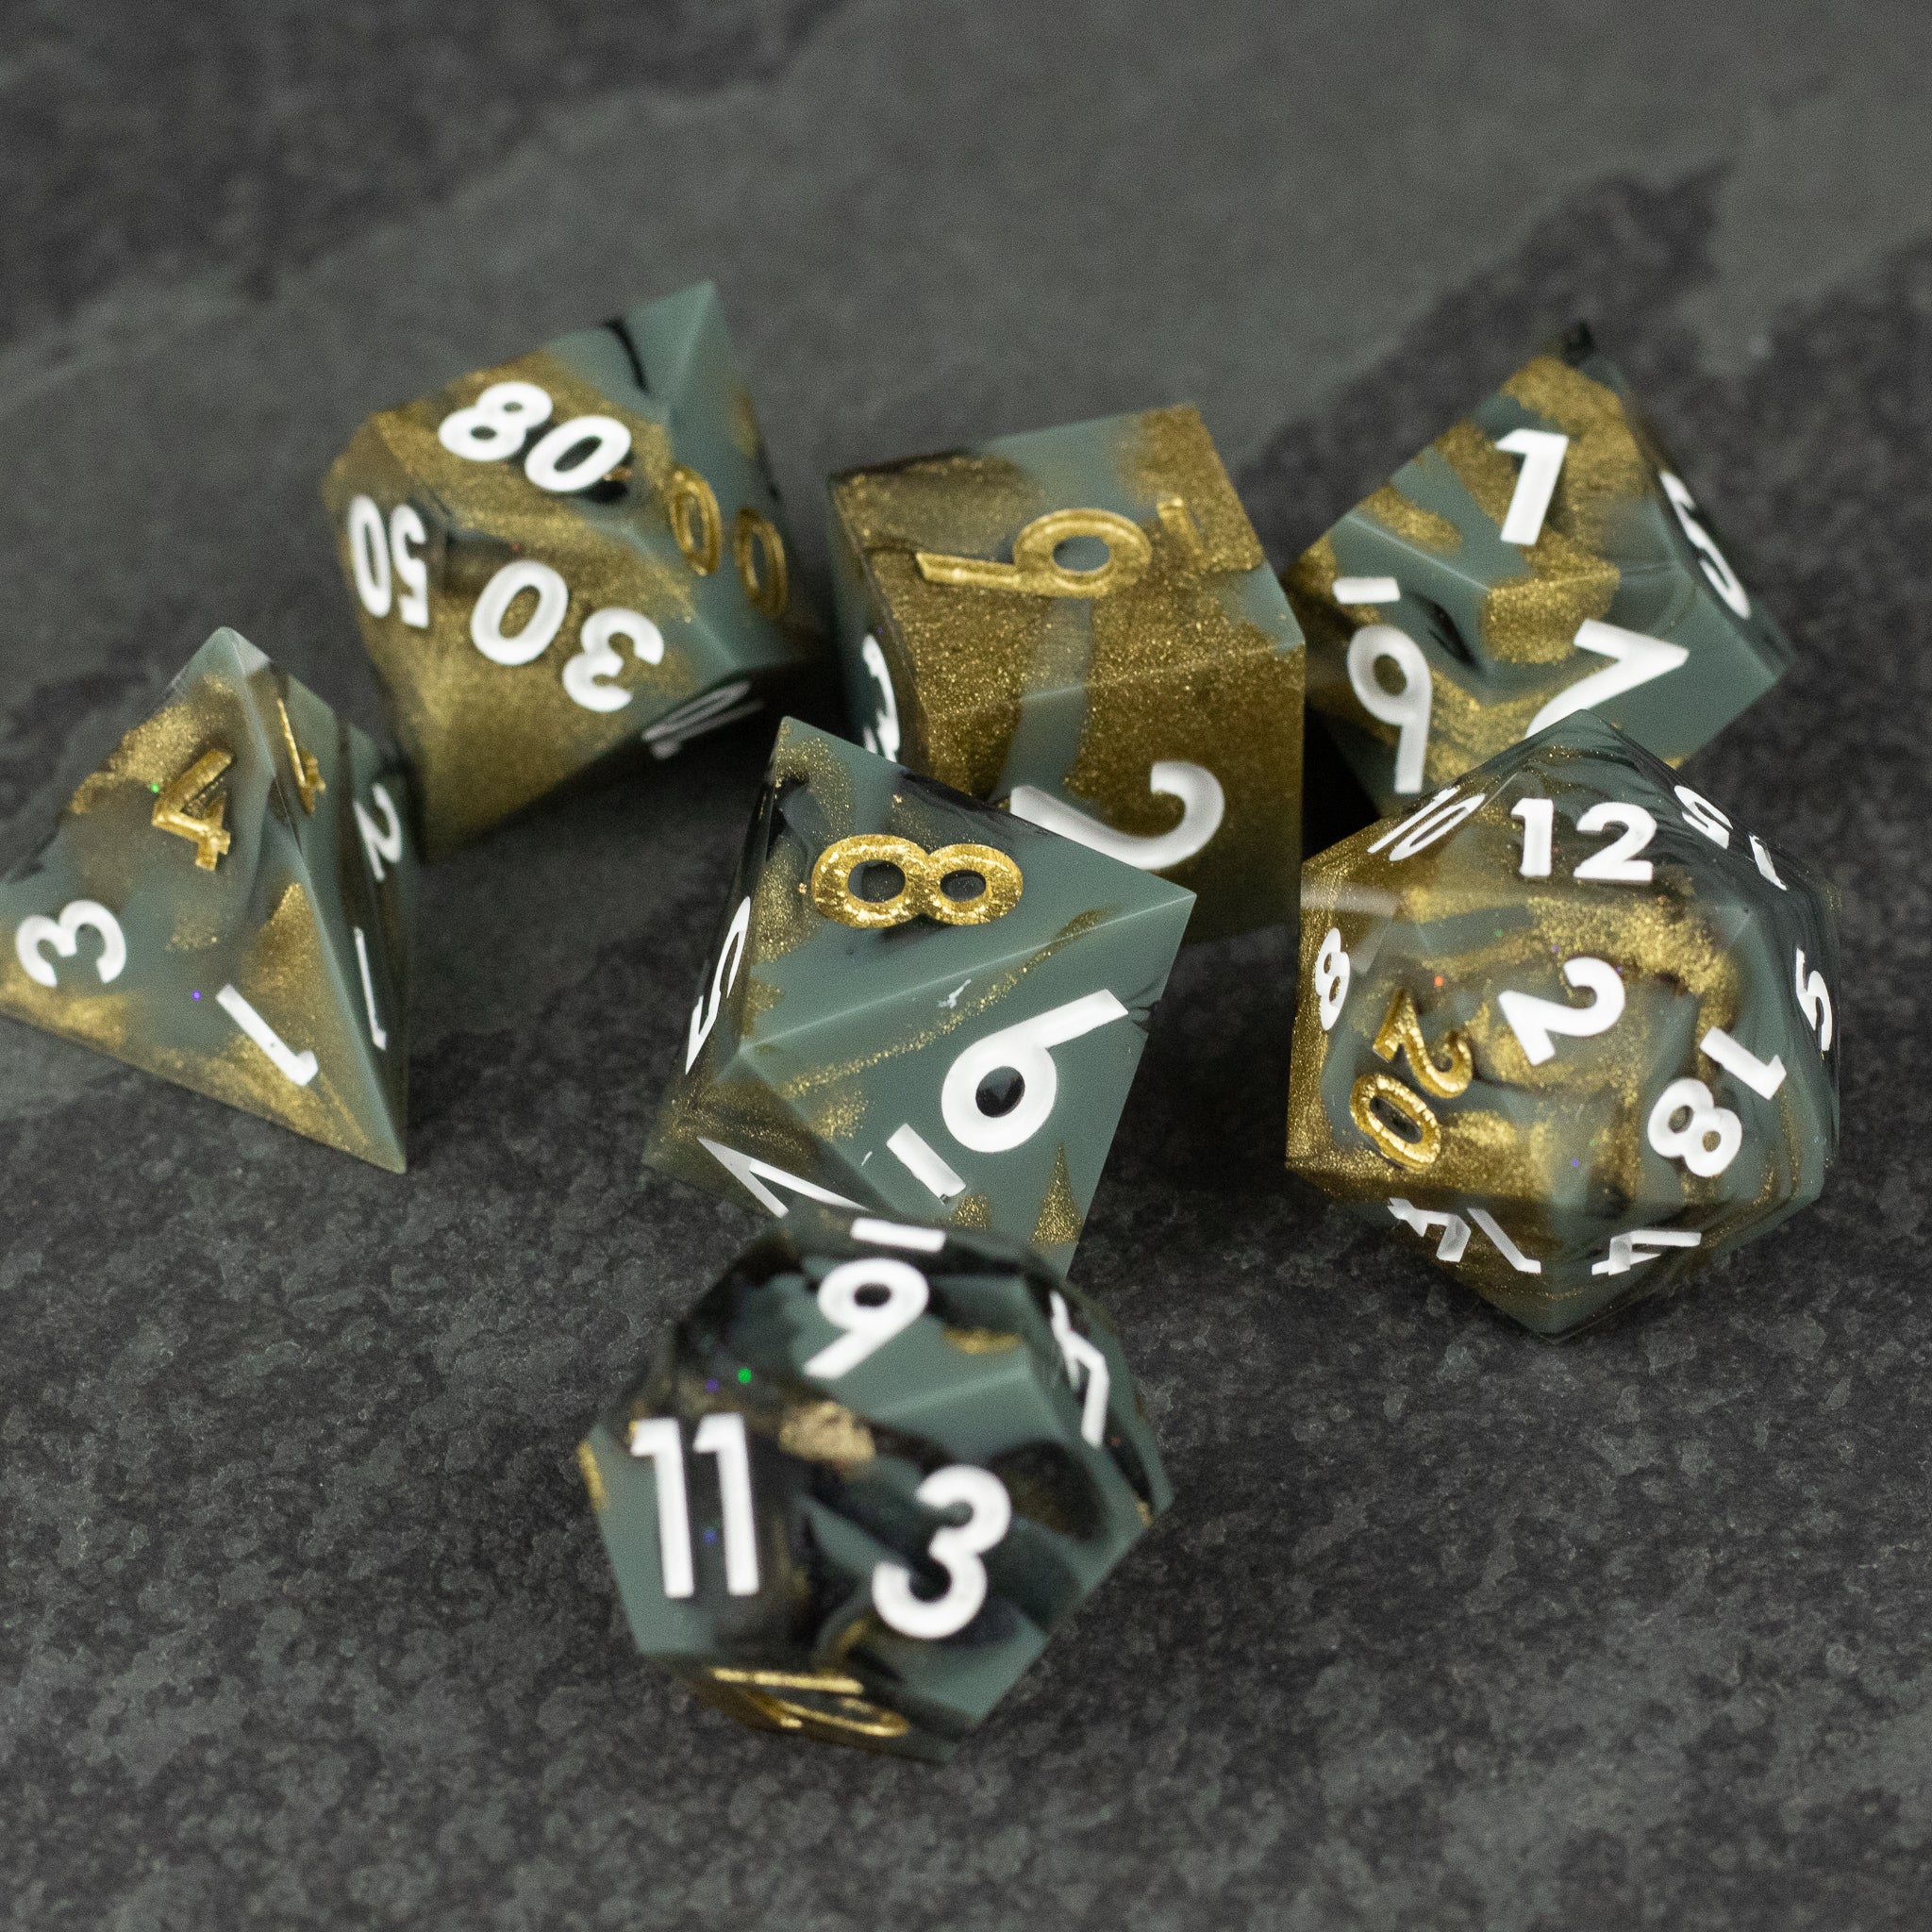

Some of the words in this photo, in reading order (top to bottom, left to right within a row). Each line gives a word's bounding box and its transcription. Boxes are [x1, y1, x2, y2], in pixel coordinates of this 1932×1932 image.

[437, 381, 632, 492] 80
[1495, 428, 1570, 545] 1
[349, 495, 429, 628] 50
[471, 560, 664, 712] 30
[1524, 619, 1689, 740] 7
[152, 749, 235, 871] 4
[355, 783, 403, 882] 2
[1367, 783, 1487, 861] 10
[1510, 797, 1657, 882] 12
[812, 833, 1024, 928] 8
[15, 899, 127, 988] 3
[354, 927, 387, 1051] 1
[1314, 927, 1351, 1032] 8
[216, 984, 319, 1087] 1
[1497, 957, 1625, 1066] 2
[1795, 947, 1833, 1052] 5
[1349, 987, 1474, 1172] 20
[1647, 1026, 1788, 1178] 18
[1387, 1196, 1541, 1274] 14
[1591, 1229, 1702, 1275] 4
[1049, 1291, 1111, 1448] 4
[629, 1413, 759, 1598] 11
[872, 1465, 1012, 1640] 3
